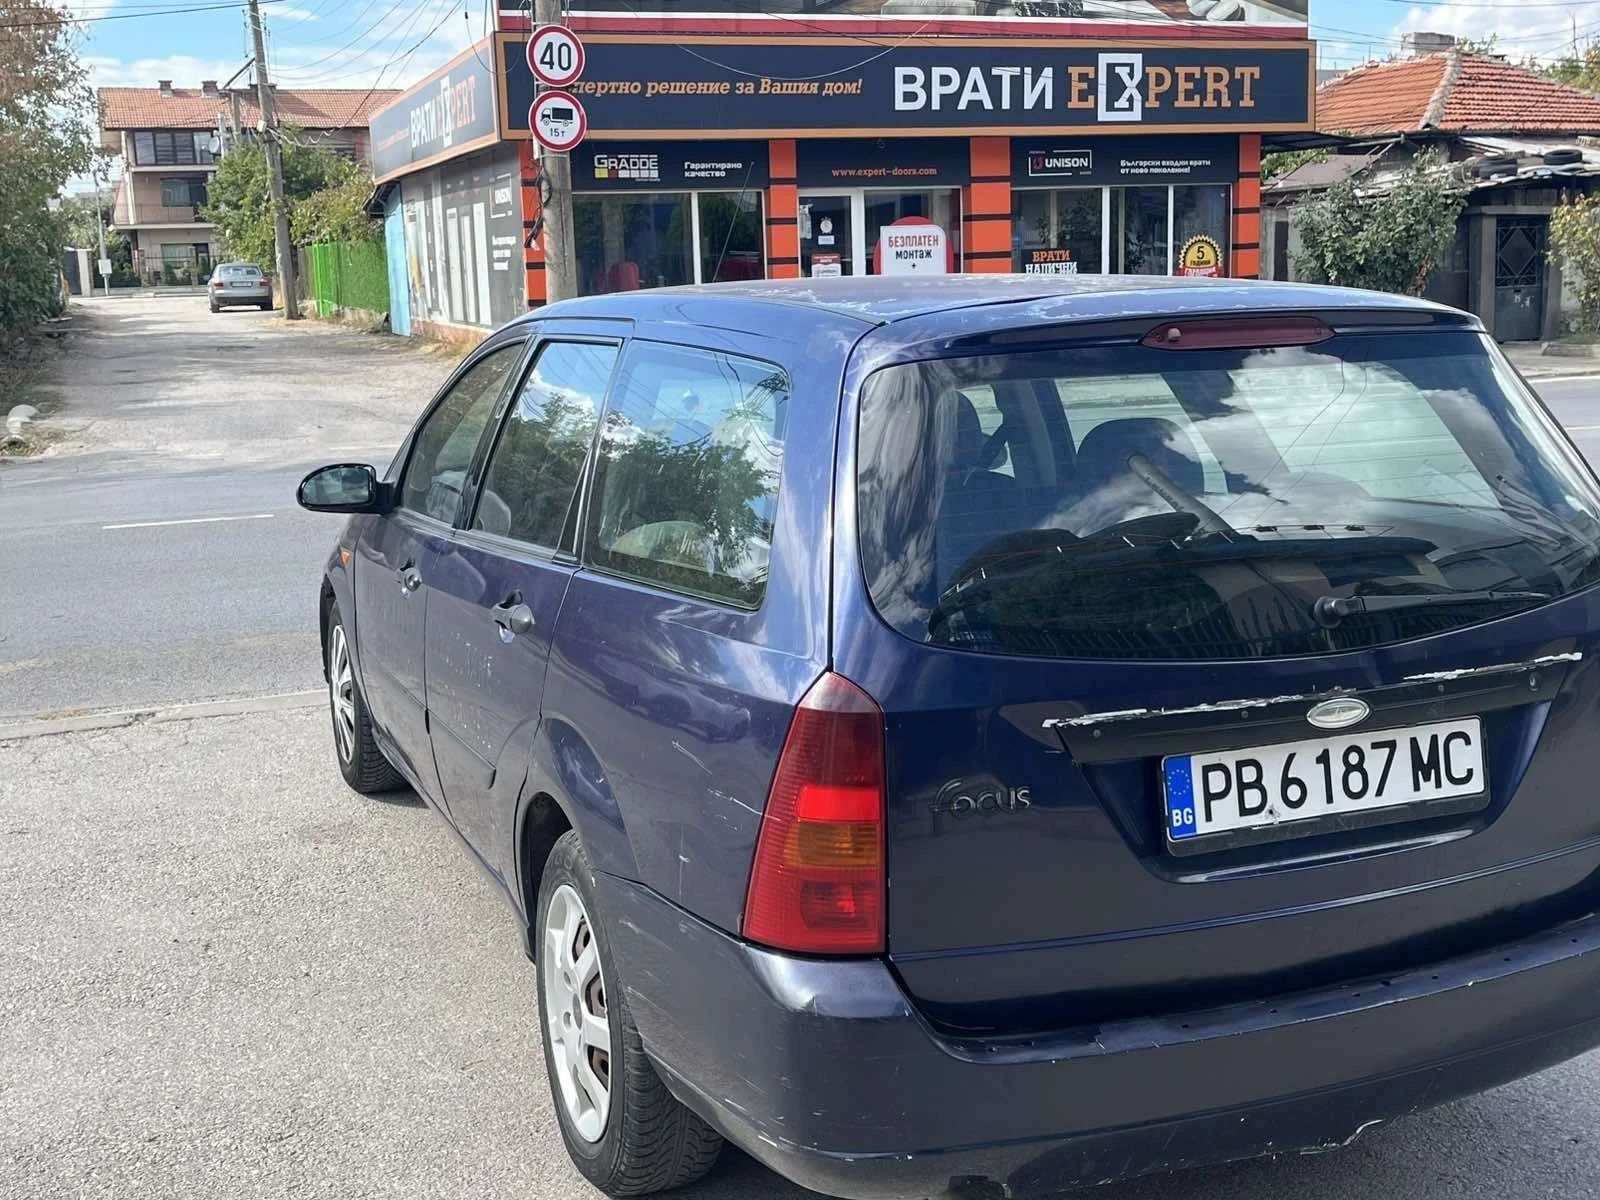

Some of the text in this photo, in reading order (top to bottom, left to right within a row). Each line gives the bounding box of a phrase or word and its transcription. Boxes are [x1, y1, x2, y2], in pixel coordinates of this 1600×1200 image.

[540, 41, 572, 71] 40
[568, 76, 863, 97] пертно решение за Вашия дом!
[894, 53, 1261, 122] ВРАТИ EXPERT
[410, 99, 437, 148] ВРАТИ
[594, 154, 659, 169] GRADDE
[684, 161, 742, 170] Гарантирано
[1045, 157, 1088, 168] UNISON
[1120, 160, 1211, 168] Български входни врати
[684, 170, 726, 178] качество
[832, 167, 937, 177] www.expert-doors.com
[888, 235, 939, 248] БЕЗПЛАТЕН
[895, 249, 932, 260] монтаж
[1032, 250, 1071, 263] ВРАТИ
[1196, 246, 1205, 260] 5
[1201, 731, 1474, 823] PB 6187 MC
[928, 778, 1031, 835] focus
[1172, 808, 1194, 828] BG
